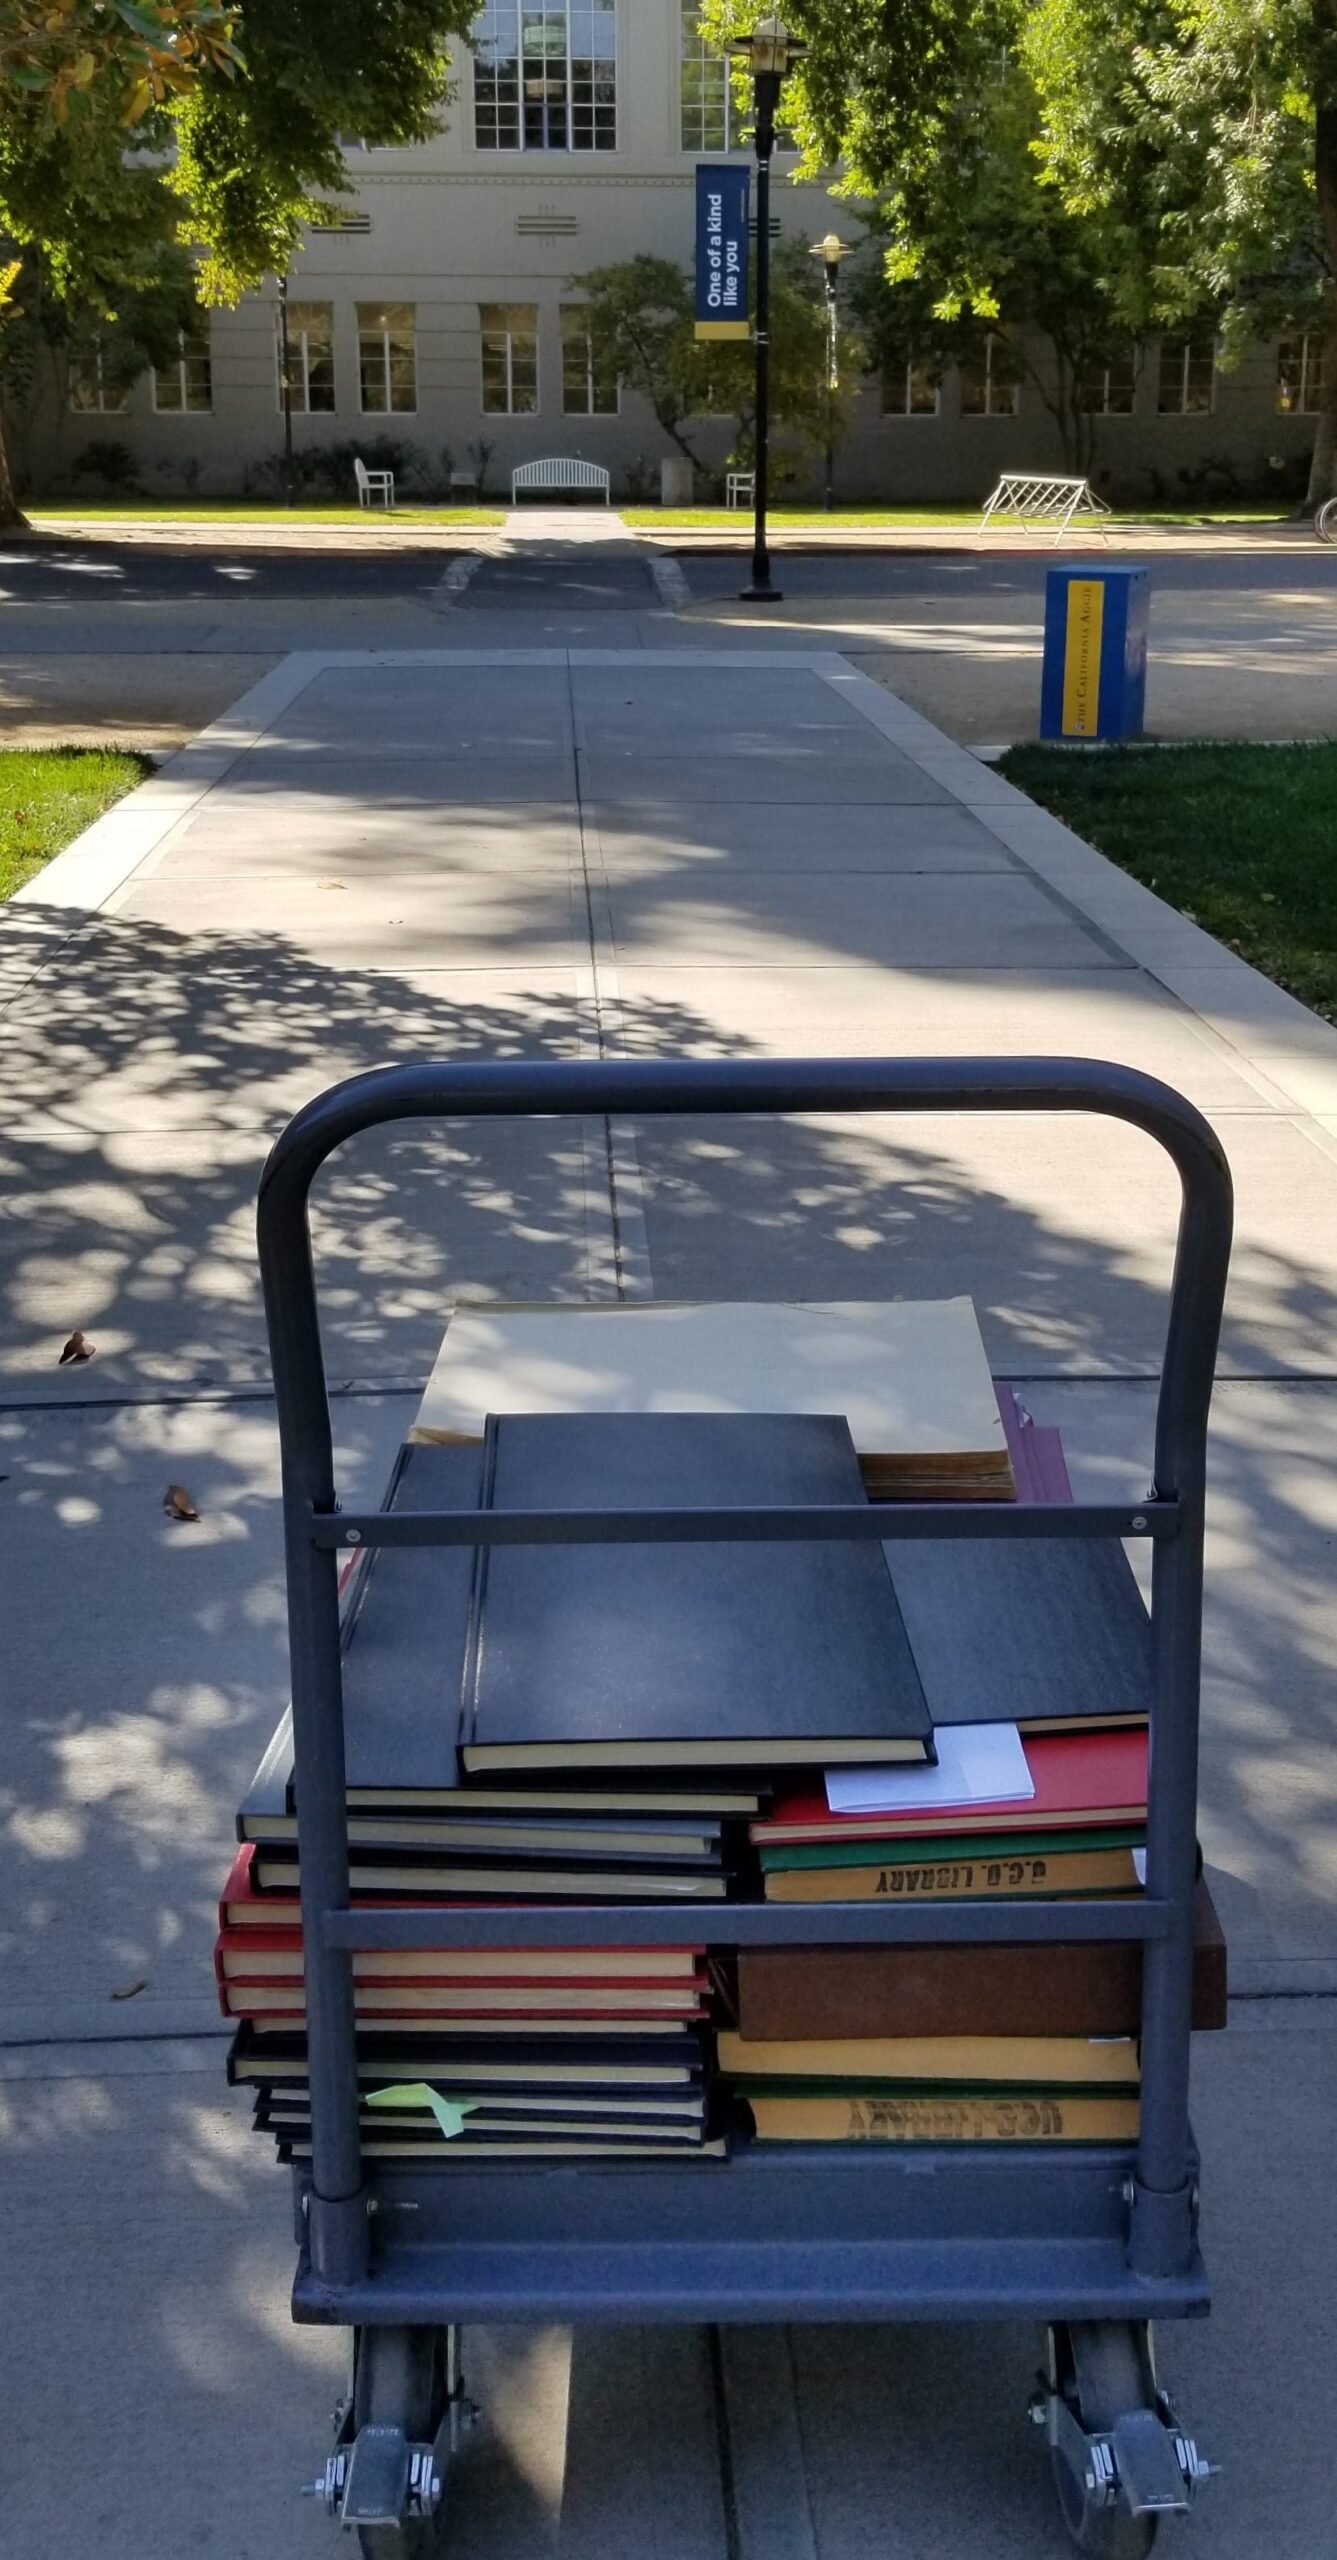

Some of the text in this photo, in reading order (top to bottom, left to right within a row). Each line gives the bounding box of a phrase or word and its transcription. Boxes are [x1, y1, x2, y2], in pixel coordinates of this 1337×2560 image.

[707, 194, 722, 307] One of a kind
[723, 241, 740, 306] like you
[875, 1866, 974, 1892] LIBRARY
